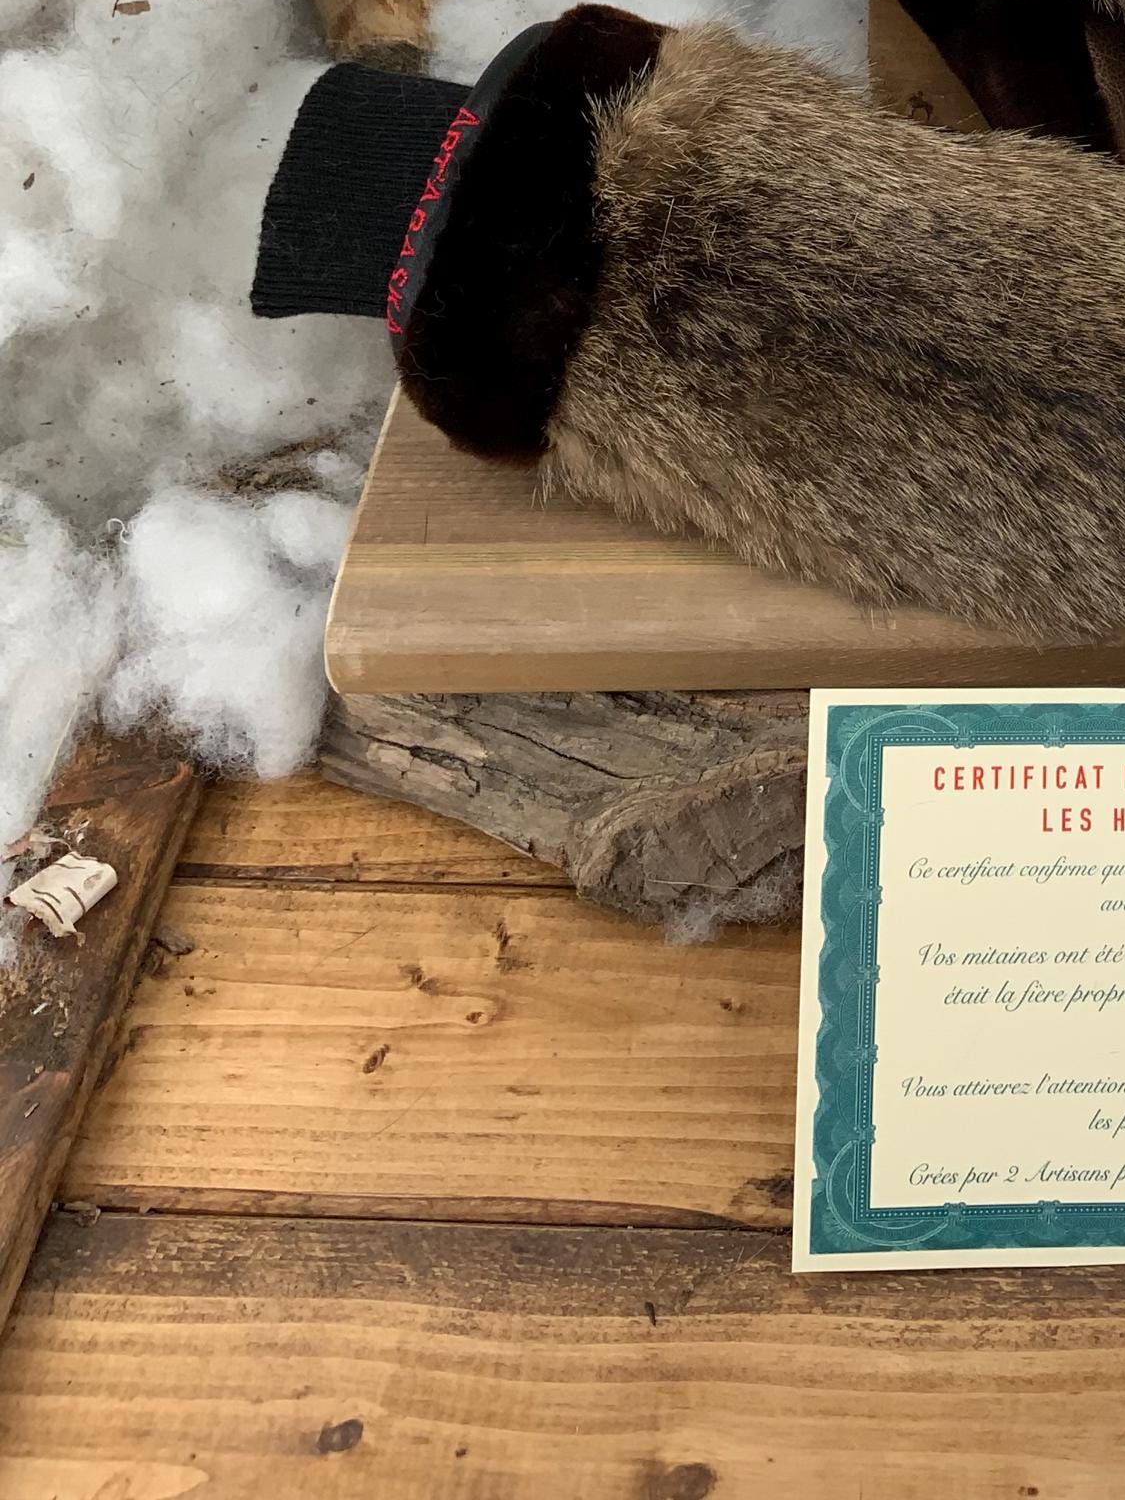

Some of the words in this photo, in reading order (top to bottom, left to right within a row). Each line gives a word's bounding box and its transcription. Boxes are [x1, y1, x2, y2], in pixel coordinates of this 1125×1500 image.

[934, 765, 1104, 791] CERTIFICAT
[1043, 808, 1092, 832] LES
[909, 858, 934, 878] Ce
[937, 857, 1016, 885] certificat
[1020, 856, 1099, 884] confirme
[919, 943, 959, 966] Vos
[961, 946, 1050, 965] mitaines
[1054, 948, 1090, 964] ont
[1095, 944, 1125, 964] été
[944, 986, 991, 1005] était
[995, 980, 1017, 1004] la
[1005, 980, 1067, 1012] fière
[902, 1076, 948, 1097] Vous
[953, 1079, 1032, 1096] attirerez
[1088, 1109, 1112, 1130] les
[909, 1163, 959, 1186] Crées
[958, 1167, 999, 1193] par
[1003, 1166, 1019, 1183] 2
[1024, 1161, 1110, 1182] Artisans
